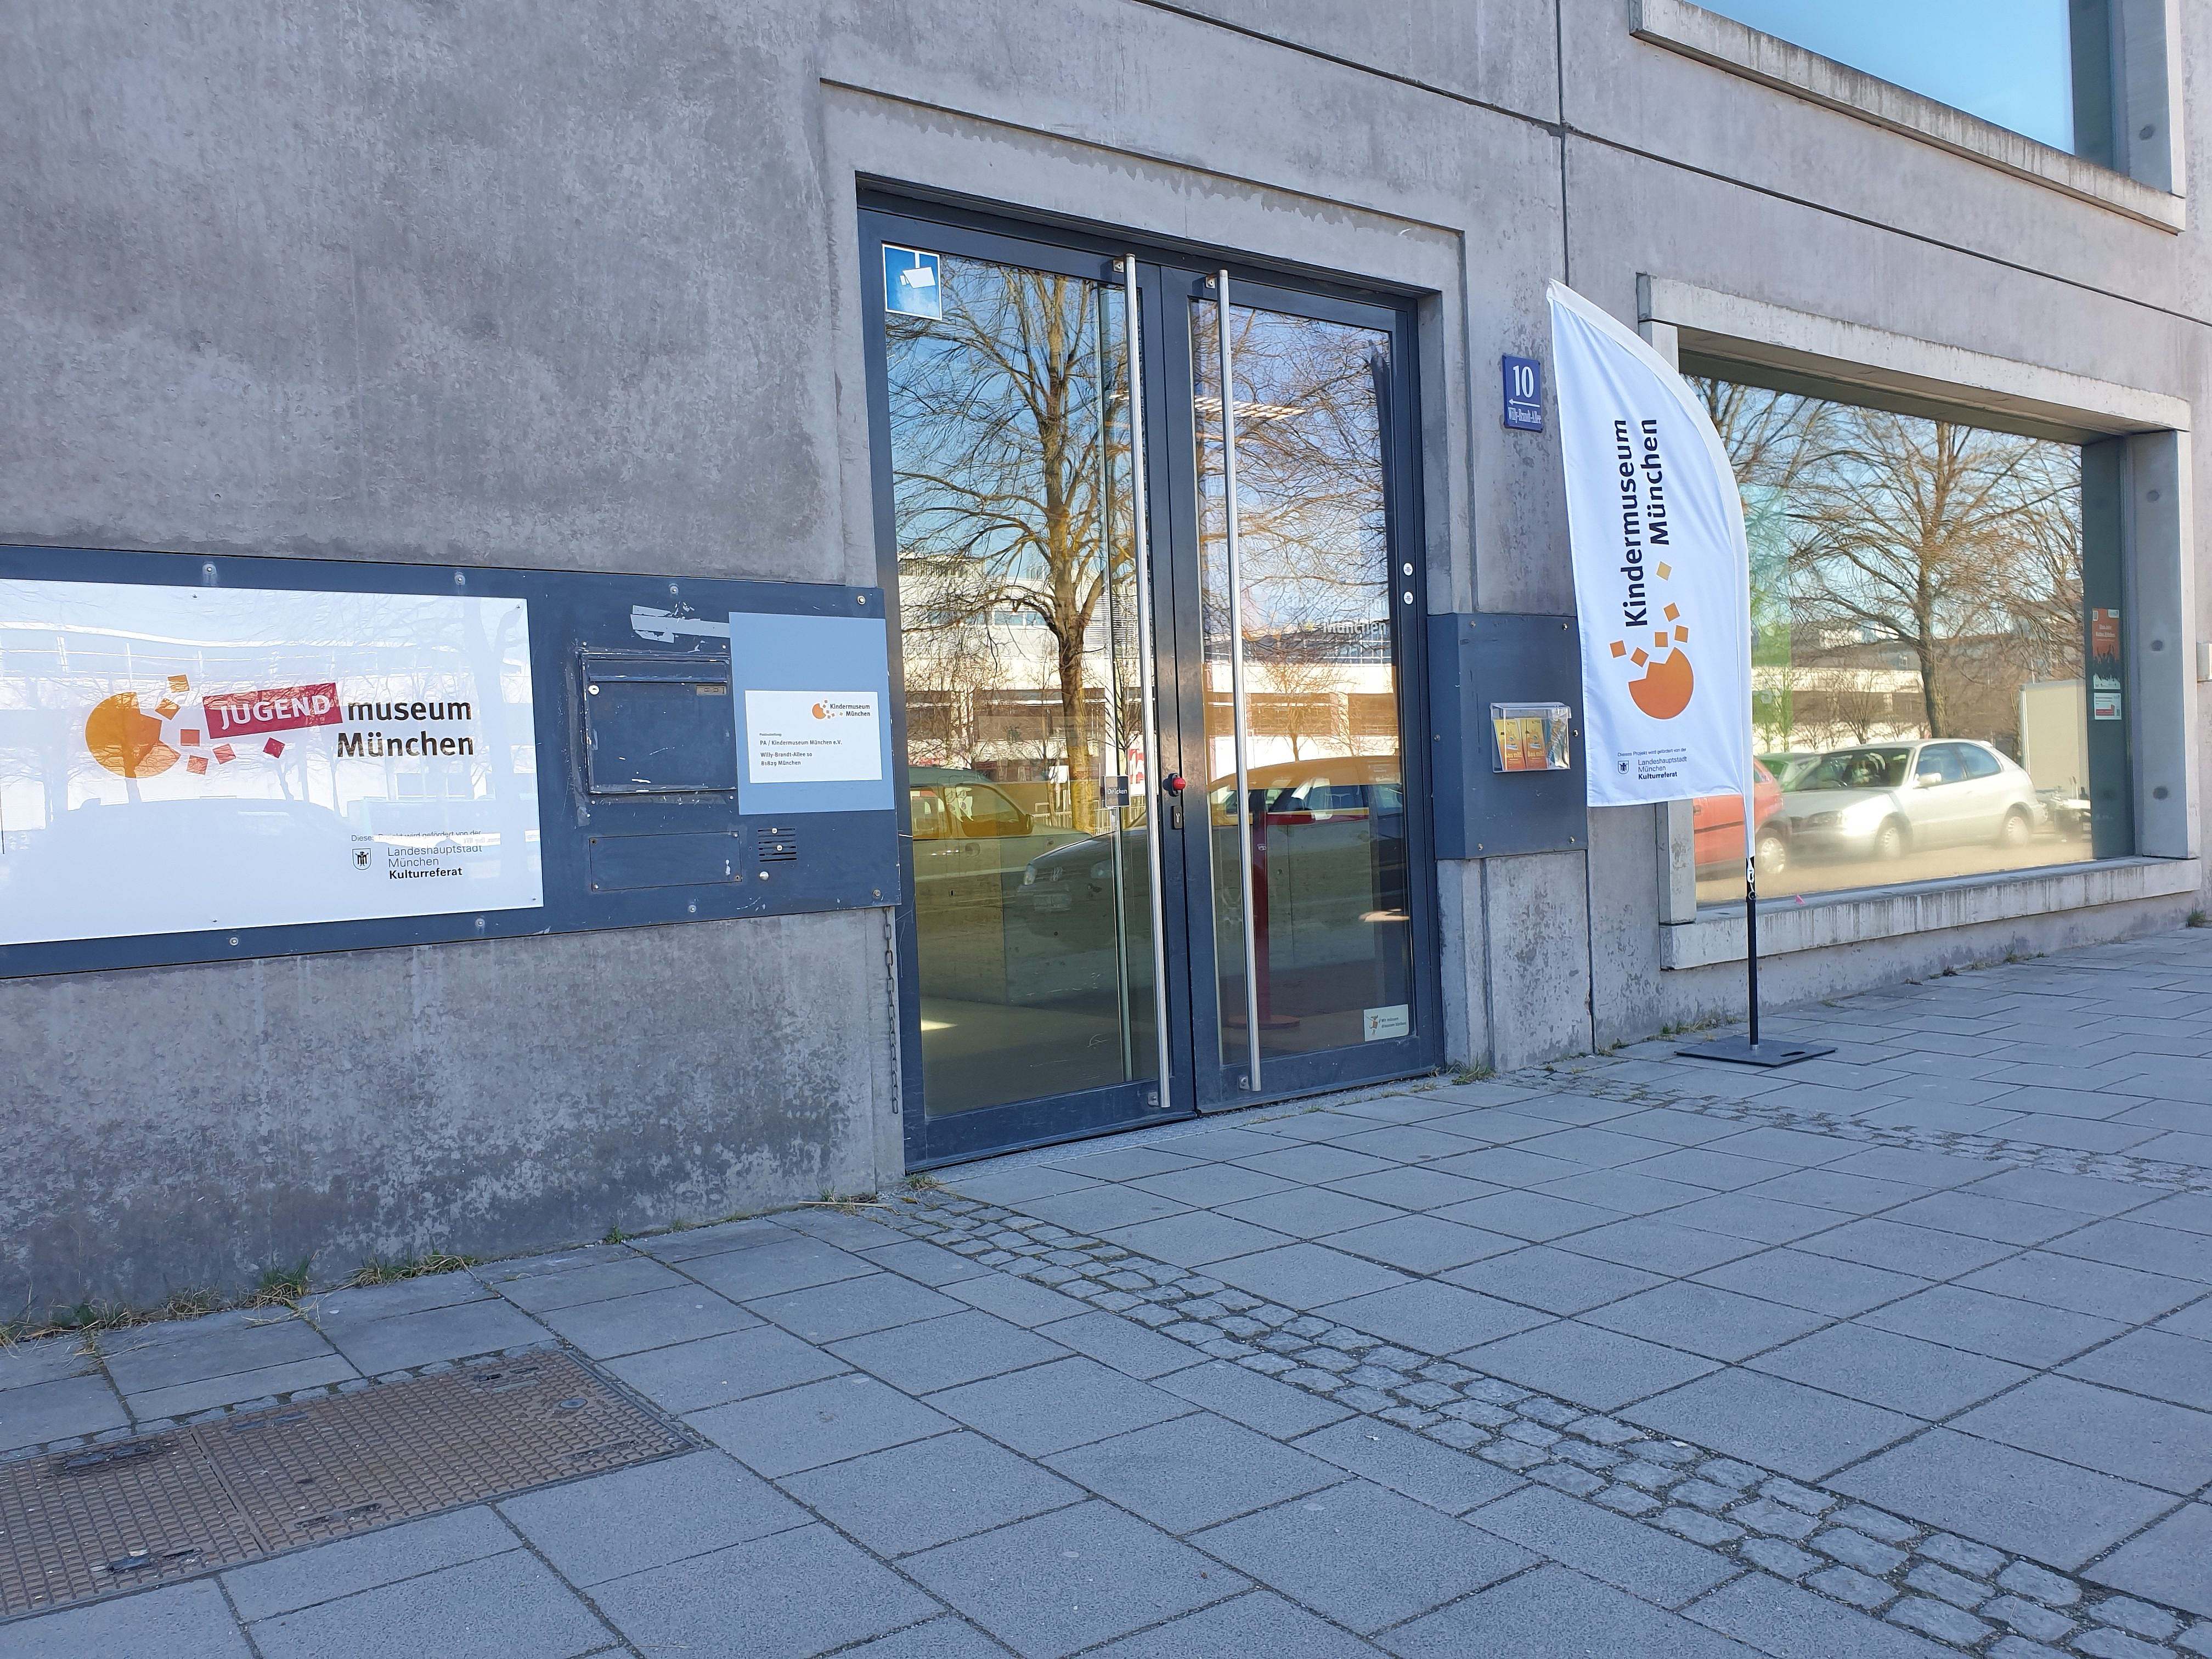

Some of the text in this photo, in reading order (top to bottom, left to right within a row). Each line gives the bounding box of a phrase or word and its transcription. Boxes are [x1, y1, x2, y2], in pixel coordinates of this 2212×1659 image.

[1513, 365, 1534, 398] 10
[1508, 407, 1541, 424] Willy-Brandt-Allee
[1640, 419, 1669, 545] München
[1615, 419, 1647, 627] Kindermuseum
[220, 695, 331, 731] JUGEND
[348, 701, 472, 721] museum
[337, 731, 474, 757] München
[1638, 757, 1687, 765] Landeshauptstadt
[388, 845, 483, 856] Landeshauptstadt
[388, 857, 439, 868] München
[390, 867, 463, 879] Kulturreferat
